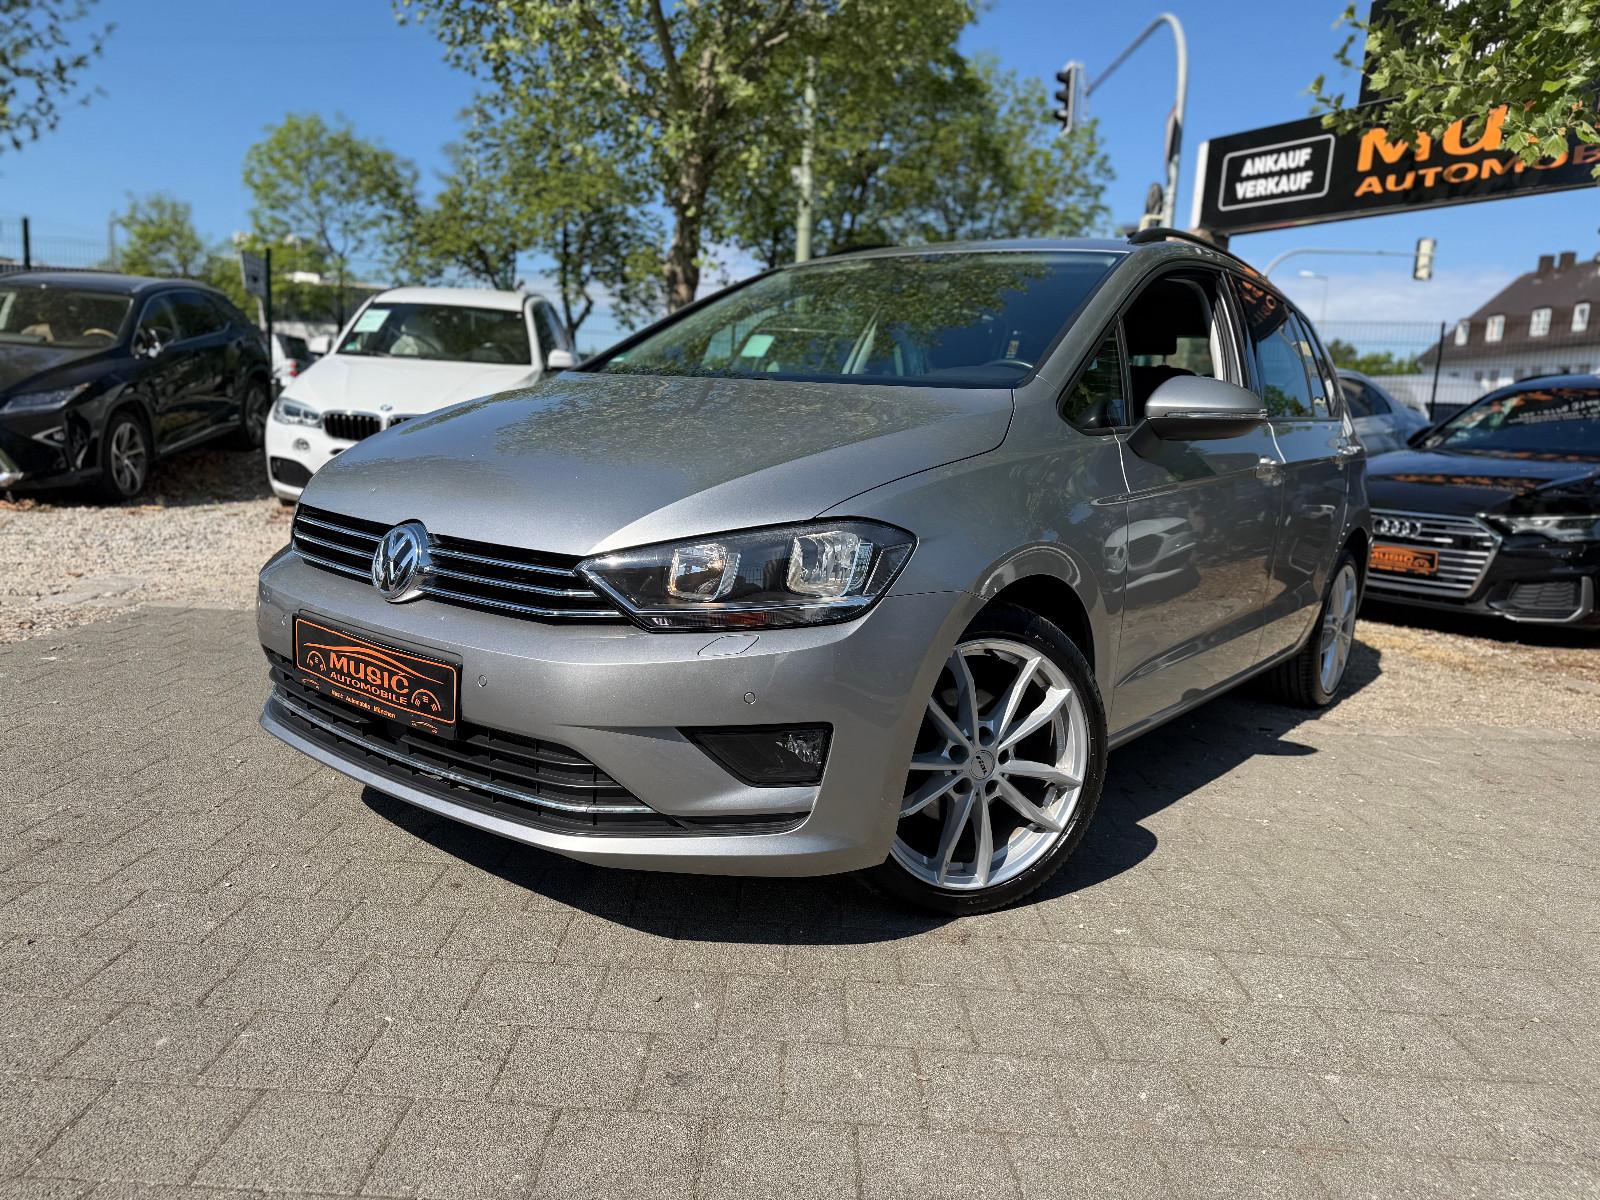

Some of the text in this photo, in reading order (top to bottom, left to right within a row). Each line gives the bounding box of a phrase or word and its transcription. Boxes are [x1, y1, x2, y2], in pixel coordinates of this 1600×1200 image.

[1241, 147, 1312, 177] ANKAUF
[1236, 170, 1314, 199] VERKAUF
[329, 651, 410, 694] MUSIC
[330, 671, 408, 706] AUTOMOBILE
